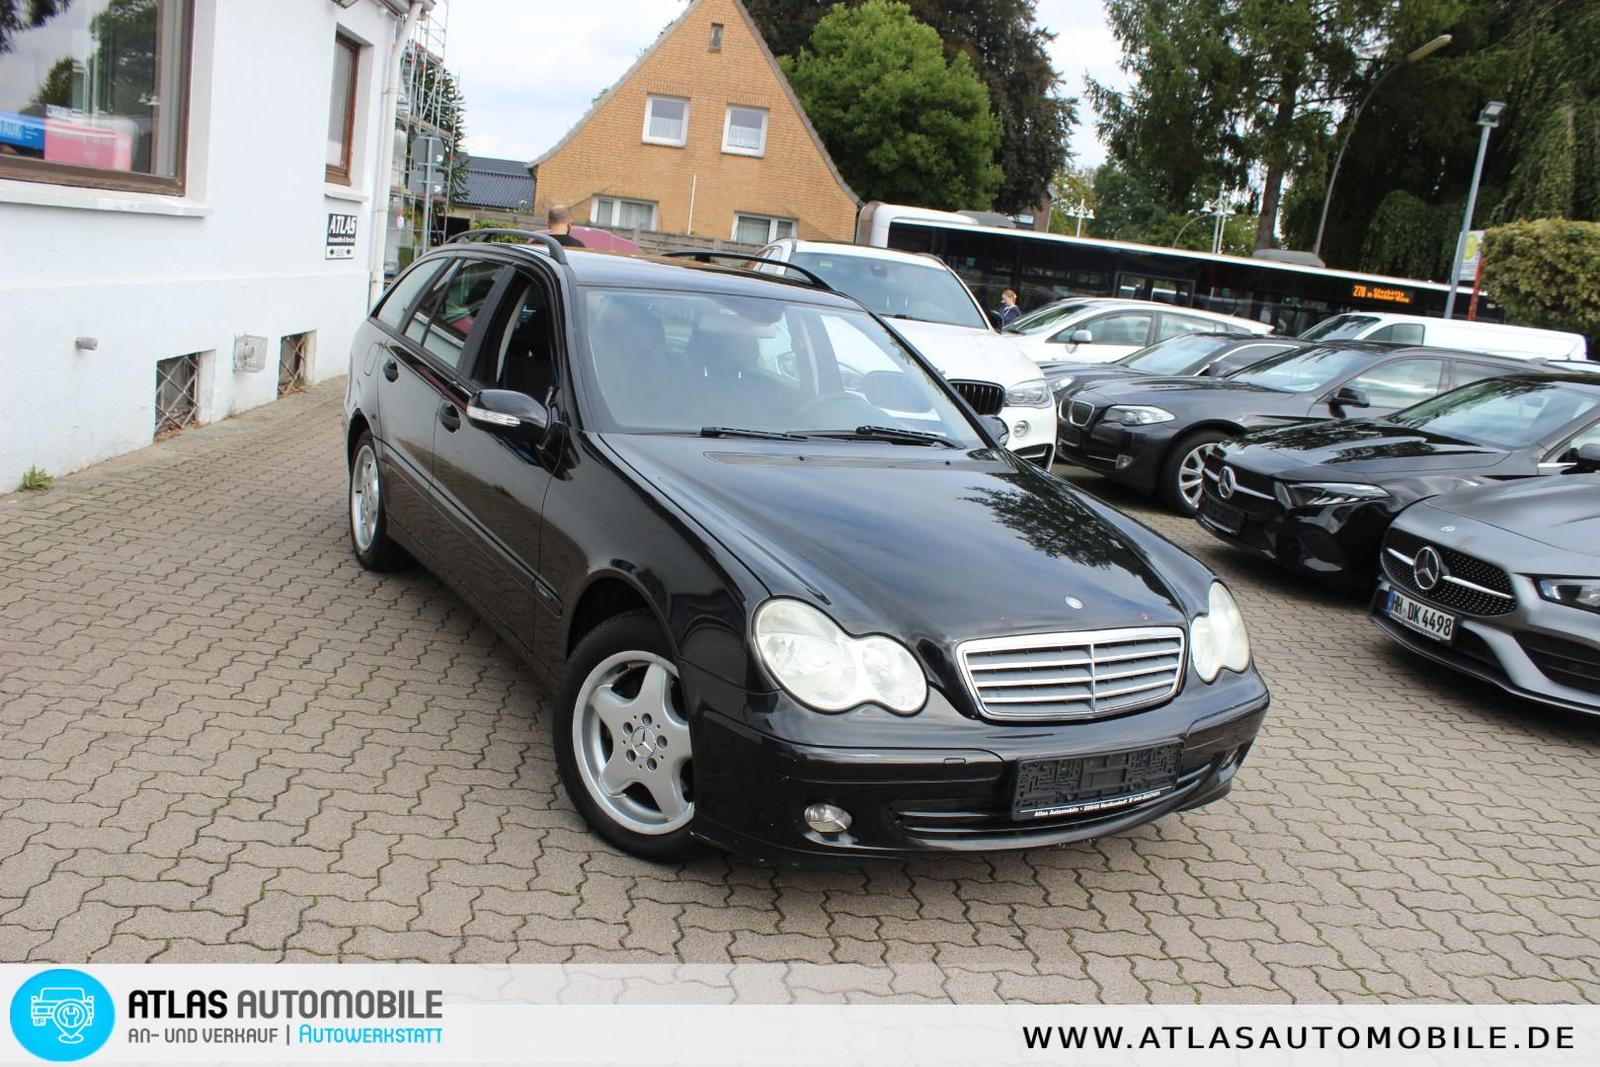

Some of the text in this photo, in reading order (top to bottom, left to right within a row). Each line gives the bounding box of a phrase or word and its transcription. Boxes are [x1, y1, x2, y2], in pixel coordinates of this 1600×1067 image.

[329, 214, 357, 235] ATLAS
[1392, 595, 1453, 637] HH DK 4498
